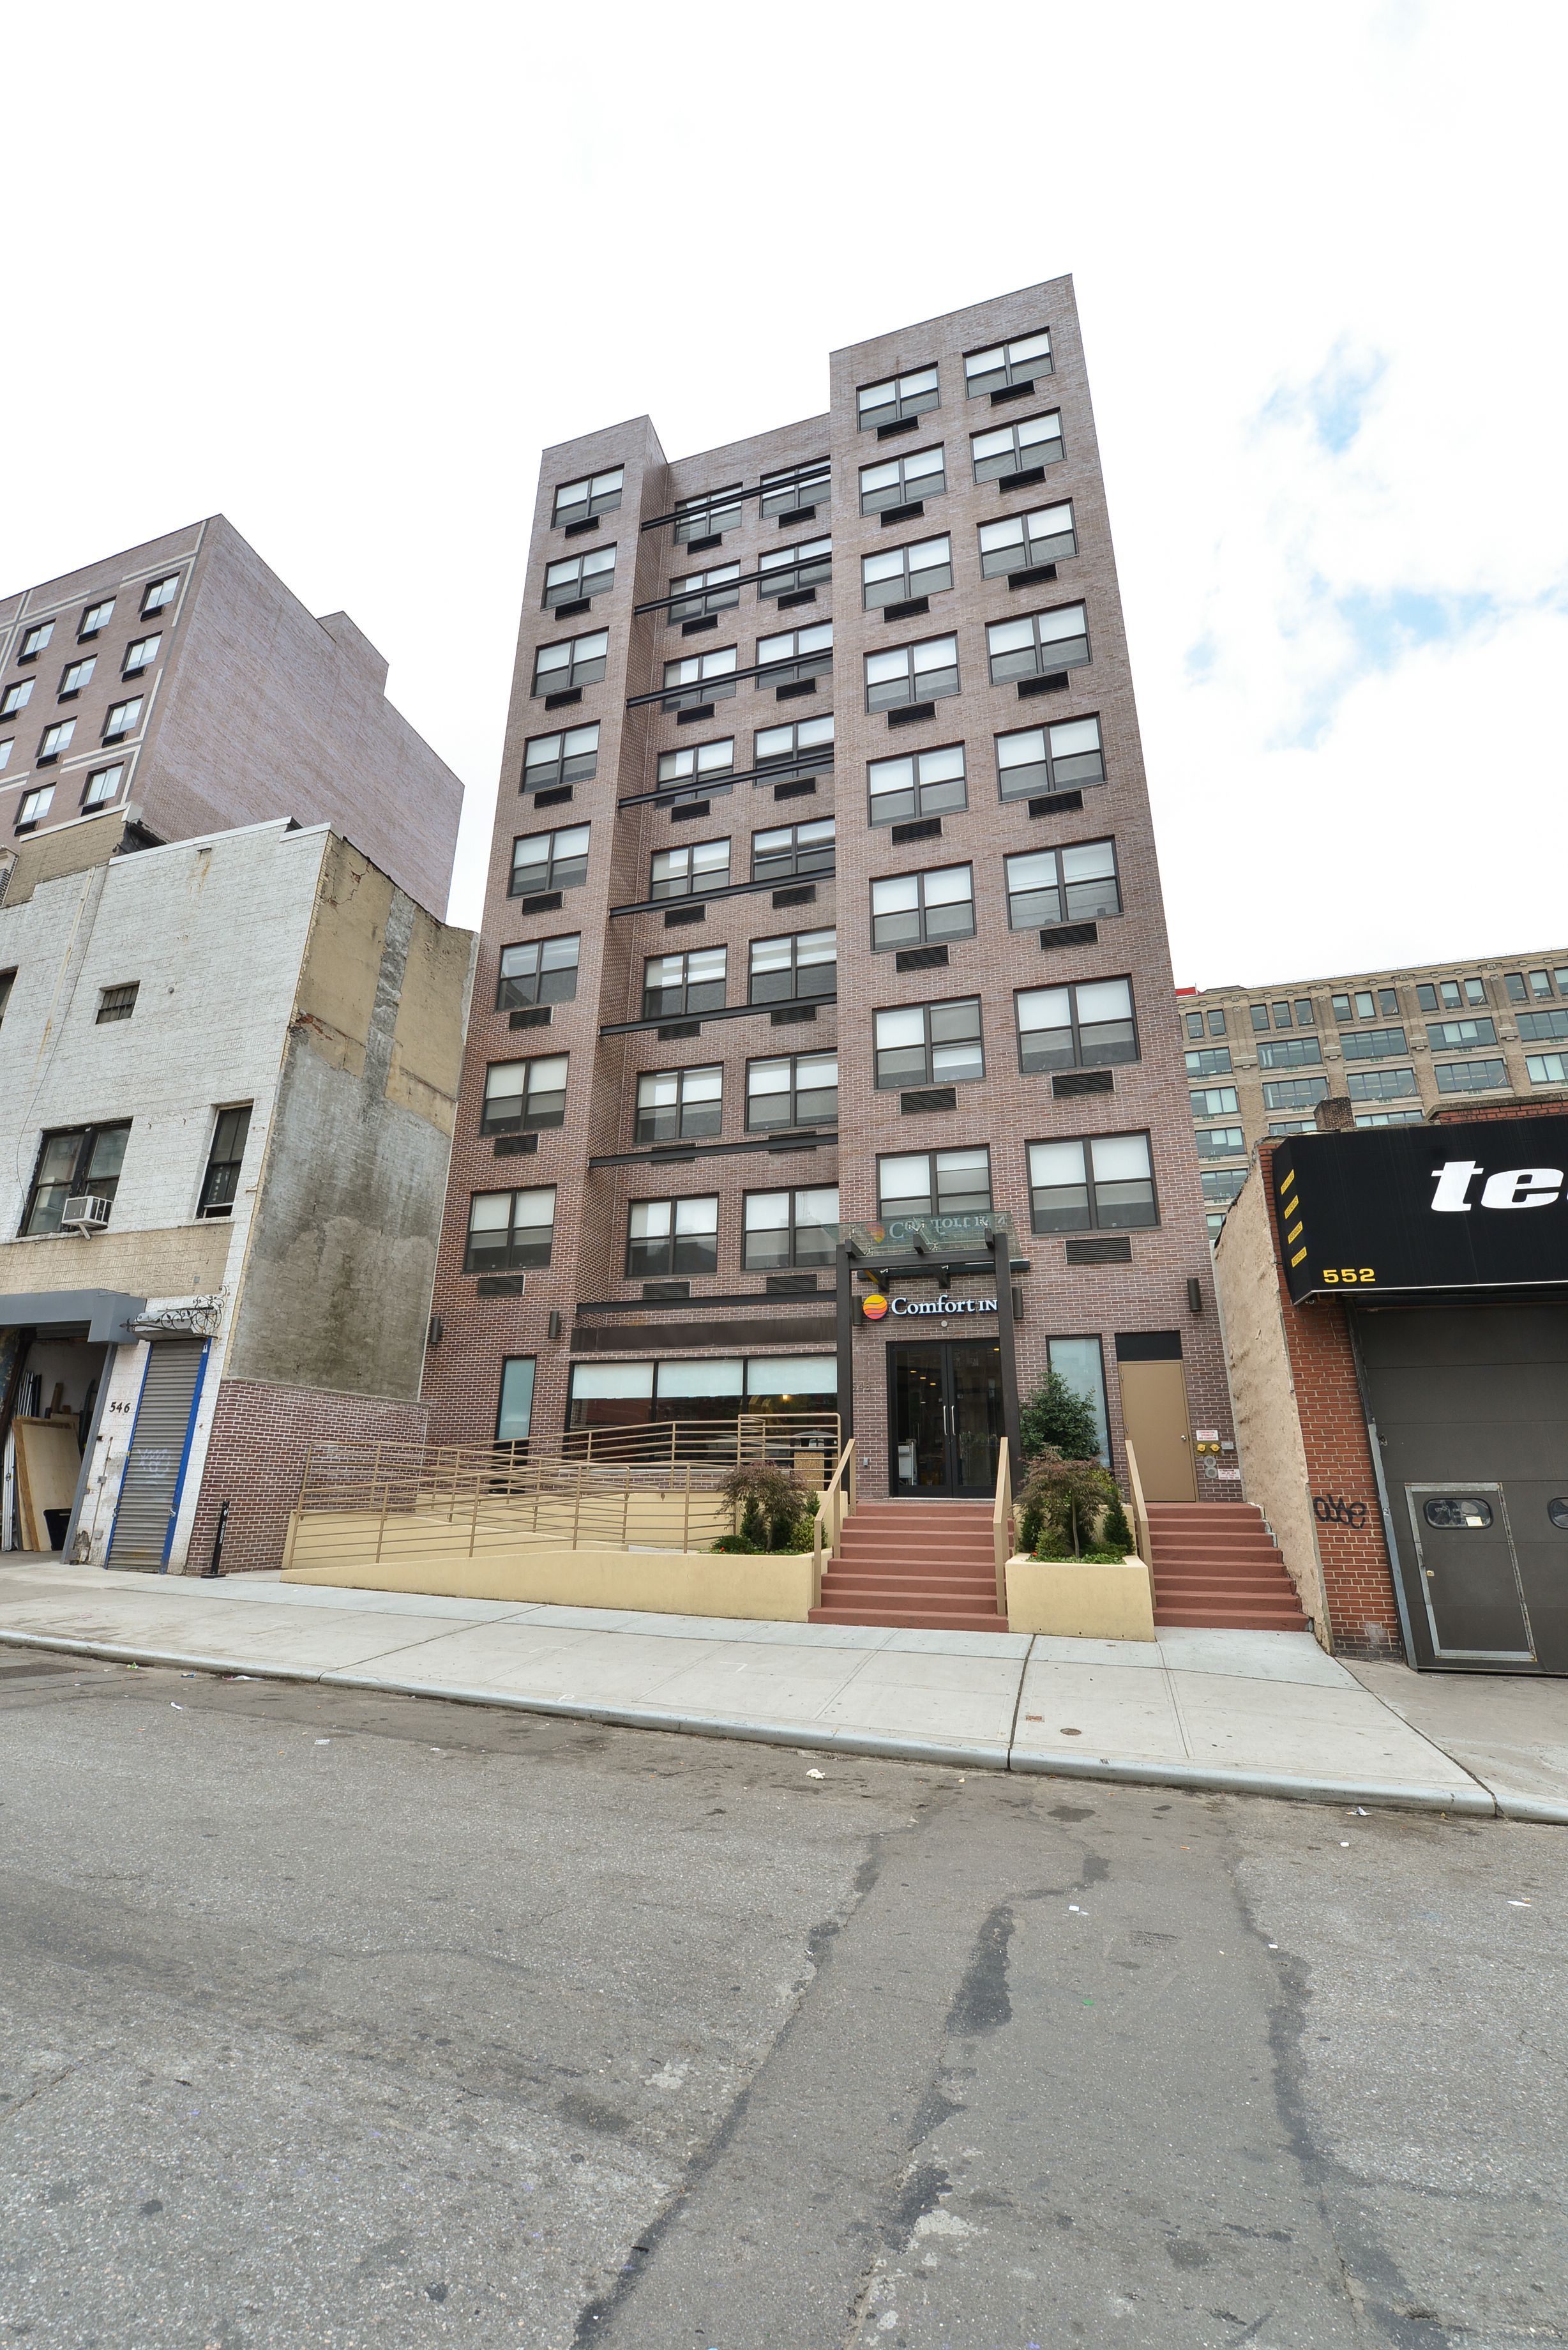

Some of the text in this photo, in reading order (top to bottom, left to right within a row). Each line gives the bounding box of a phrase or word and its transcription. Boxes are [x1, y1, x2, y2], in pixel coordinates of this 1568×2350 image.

[1431, 1160, 1568, 1211] te
[1323, 1268, 1376, 1283] 552
[891, 1294, 975, 1315] Comfort
[109, 1401, 132, 1413] 546
